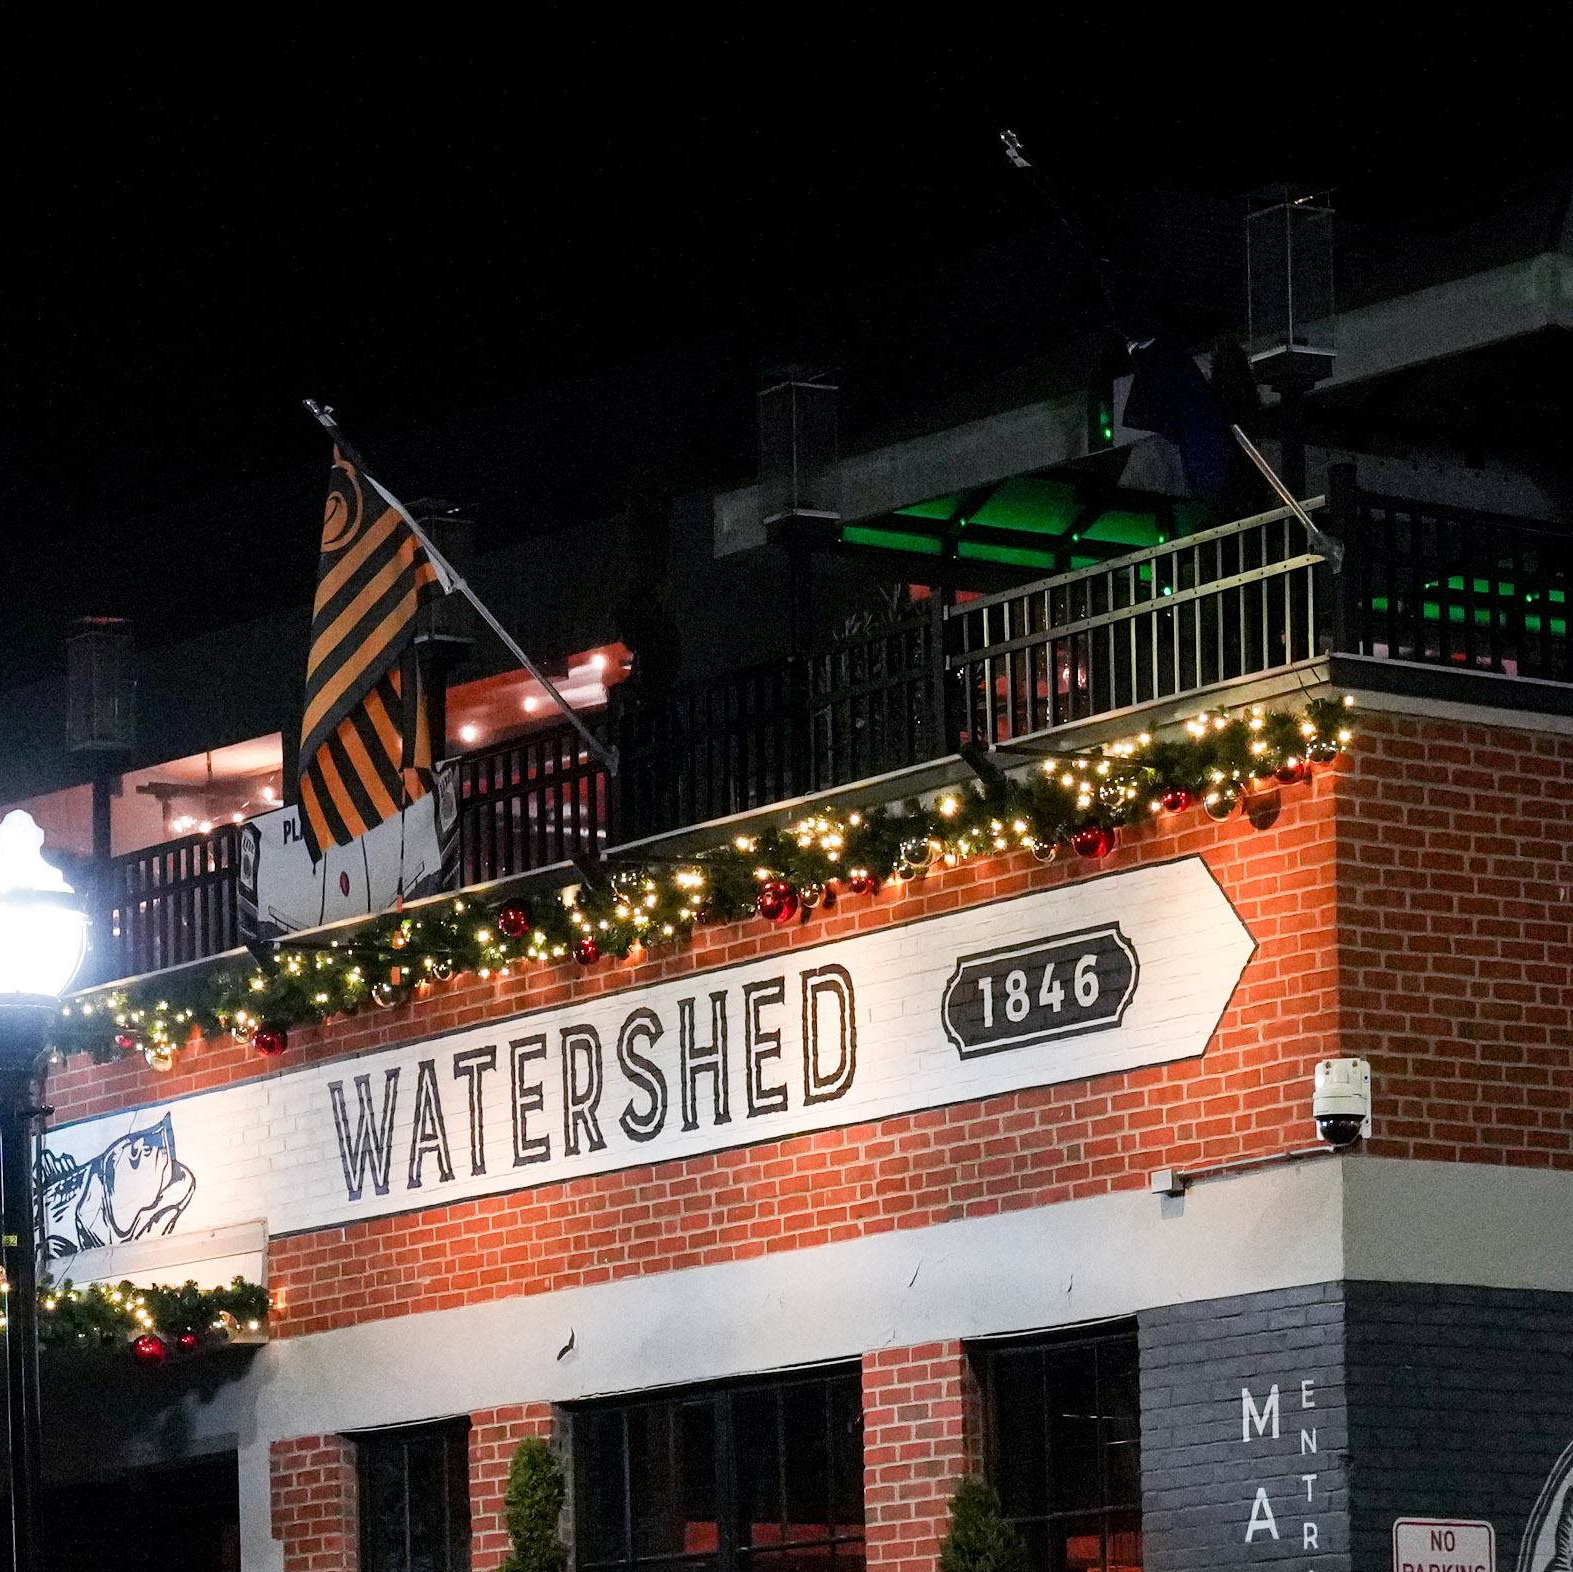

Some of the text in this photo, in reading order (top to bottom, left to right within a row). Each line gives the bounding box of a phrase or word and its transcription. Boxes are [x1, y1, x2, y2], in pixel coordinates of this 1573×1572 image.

[328, 951, 1100, 1202] WATERSHED 1846
[1431, 1530, 1455, 1552] NO
